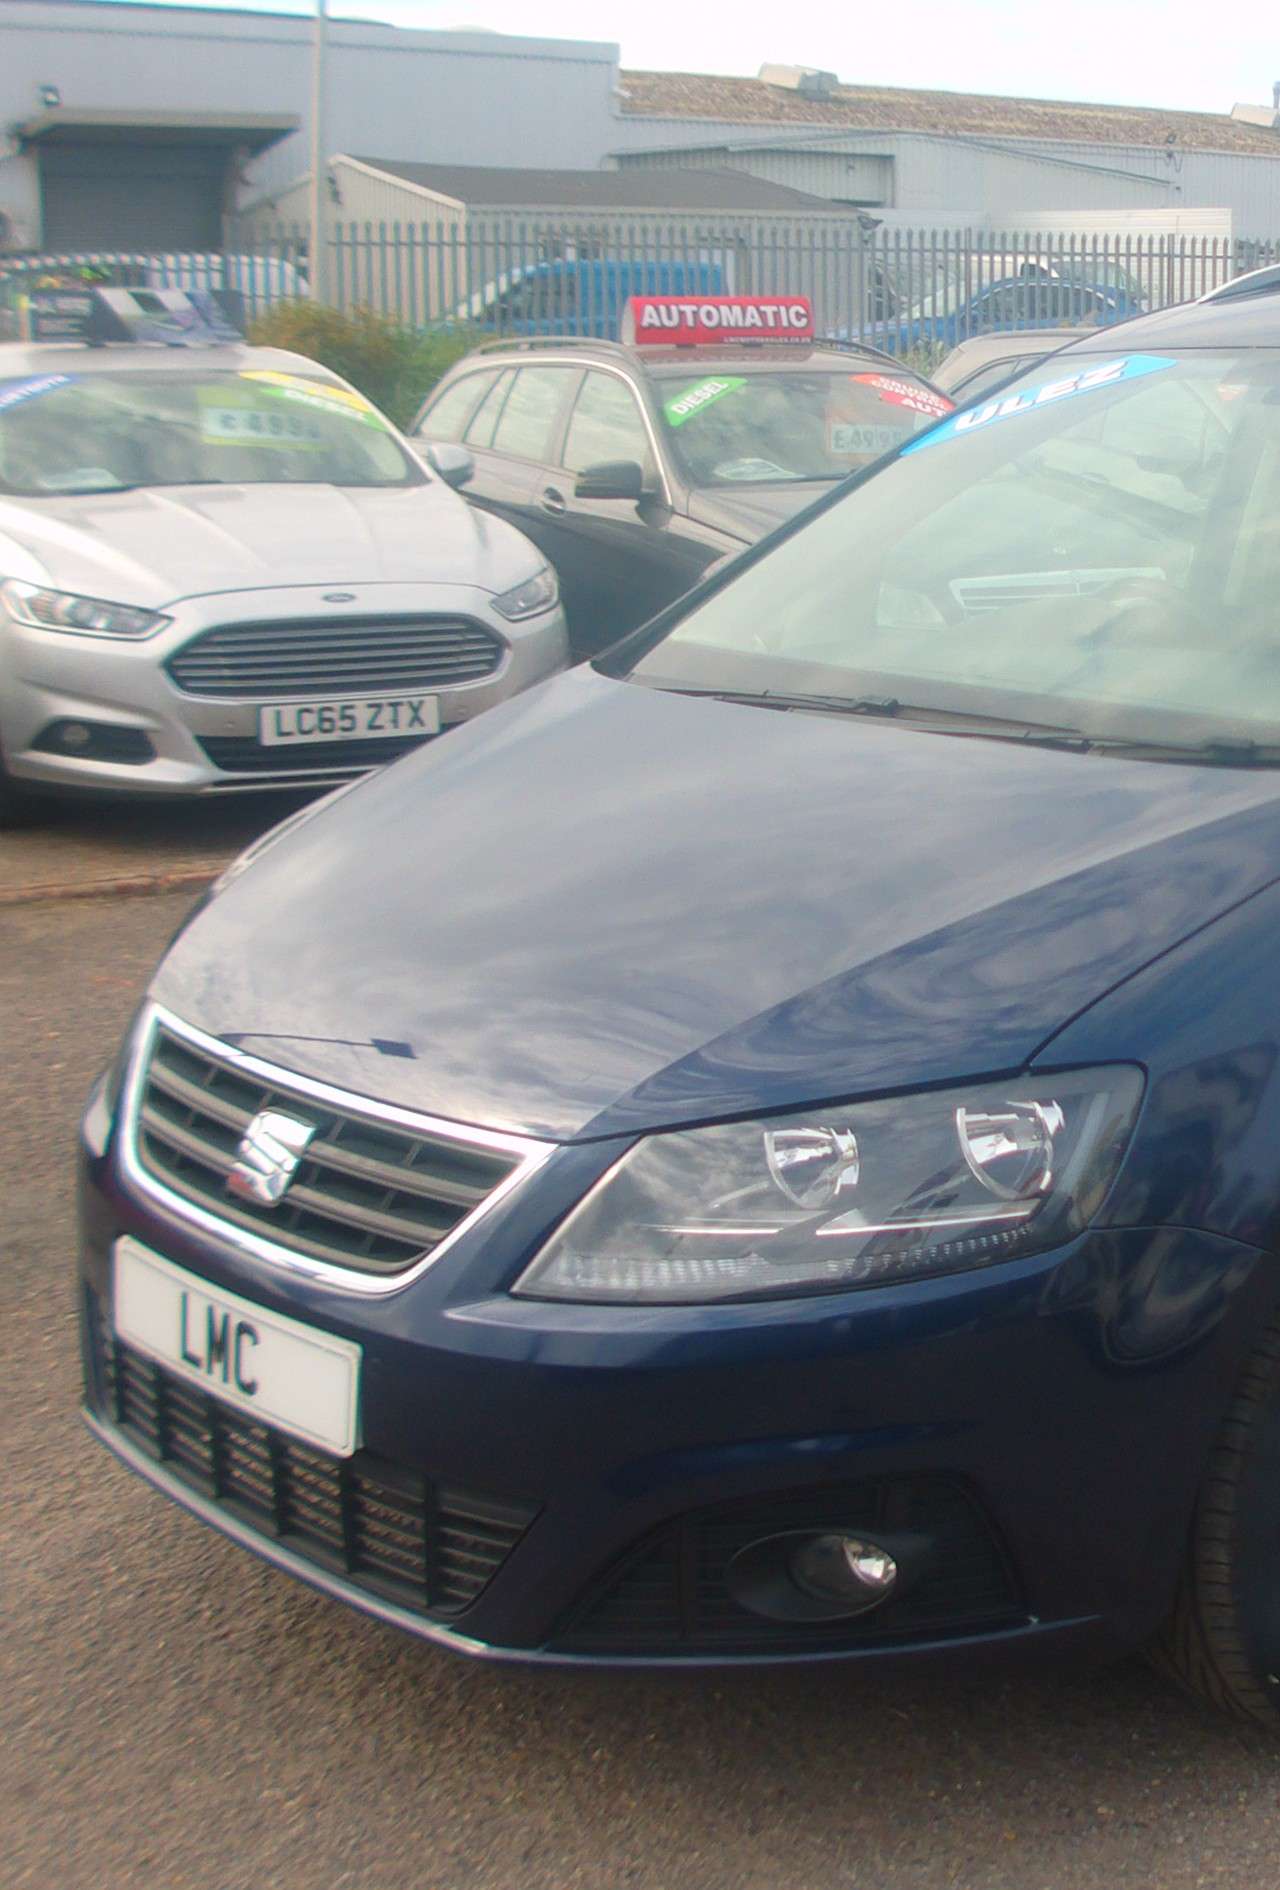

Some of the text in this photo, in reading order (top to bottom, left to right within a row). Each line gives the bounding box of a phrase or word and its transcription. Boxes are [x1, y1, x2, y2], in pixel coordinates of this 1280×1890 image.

[641, 304, 809, 329] AUTOMATIC
[671, 382, 729, 415] DIESEL
[901, 398, 947, 417] AUT
[954, 359, 1129, 431] ULEZ
[275, 700, 426, 737] LC65 ZTX
[181, 1291, 260, 1396] LMC
